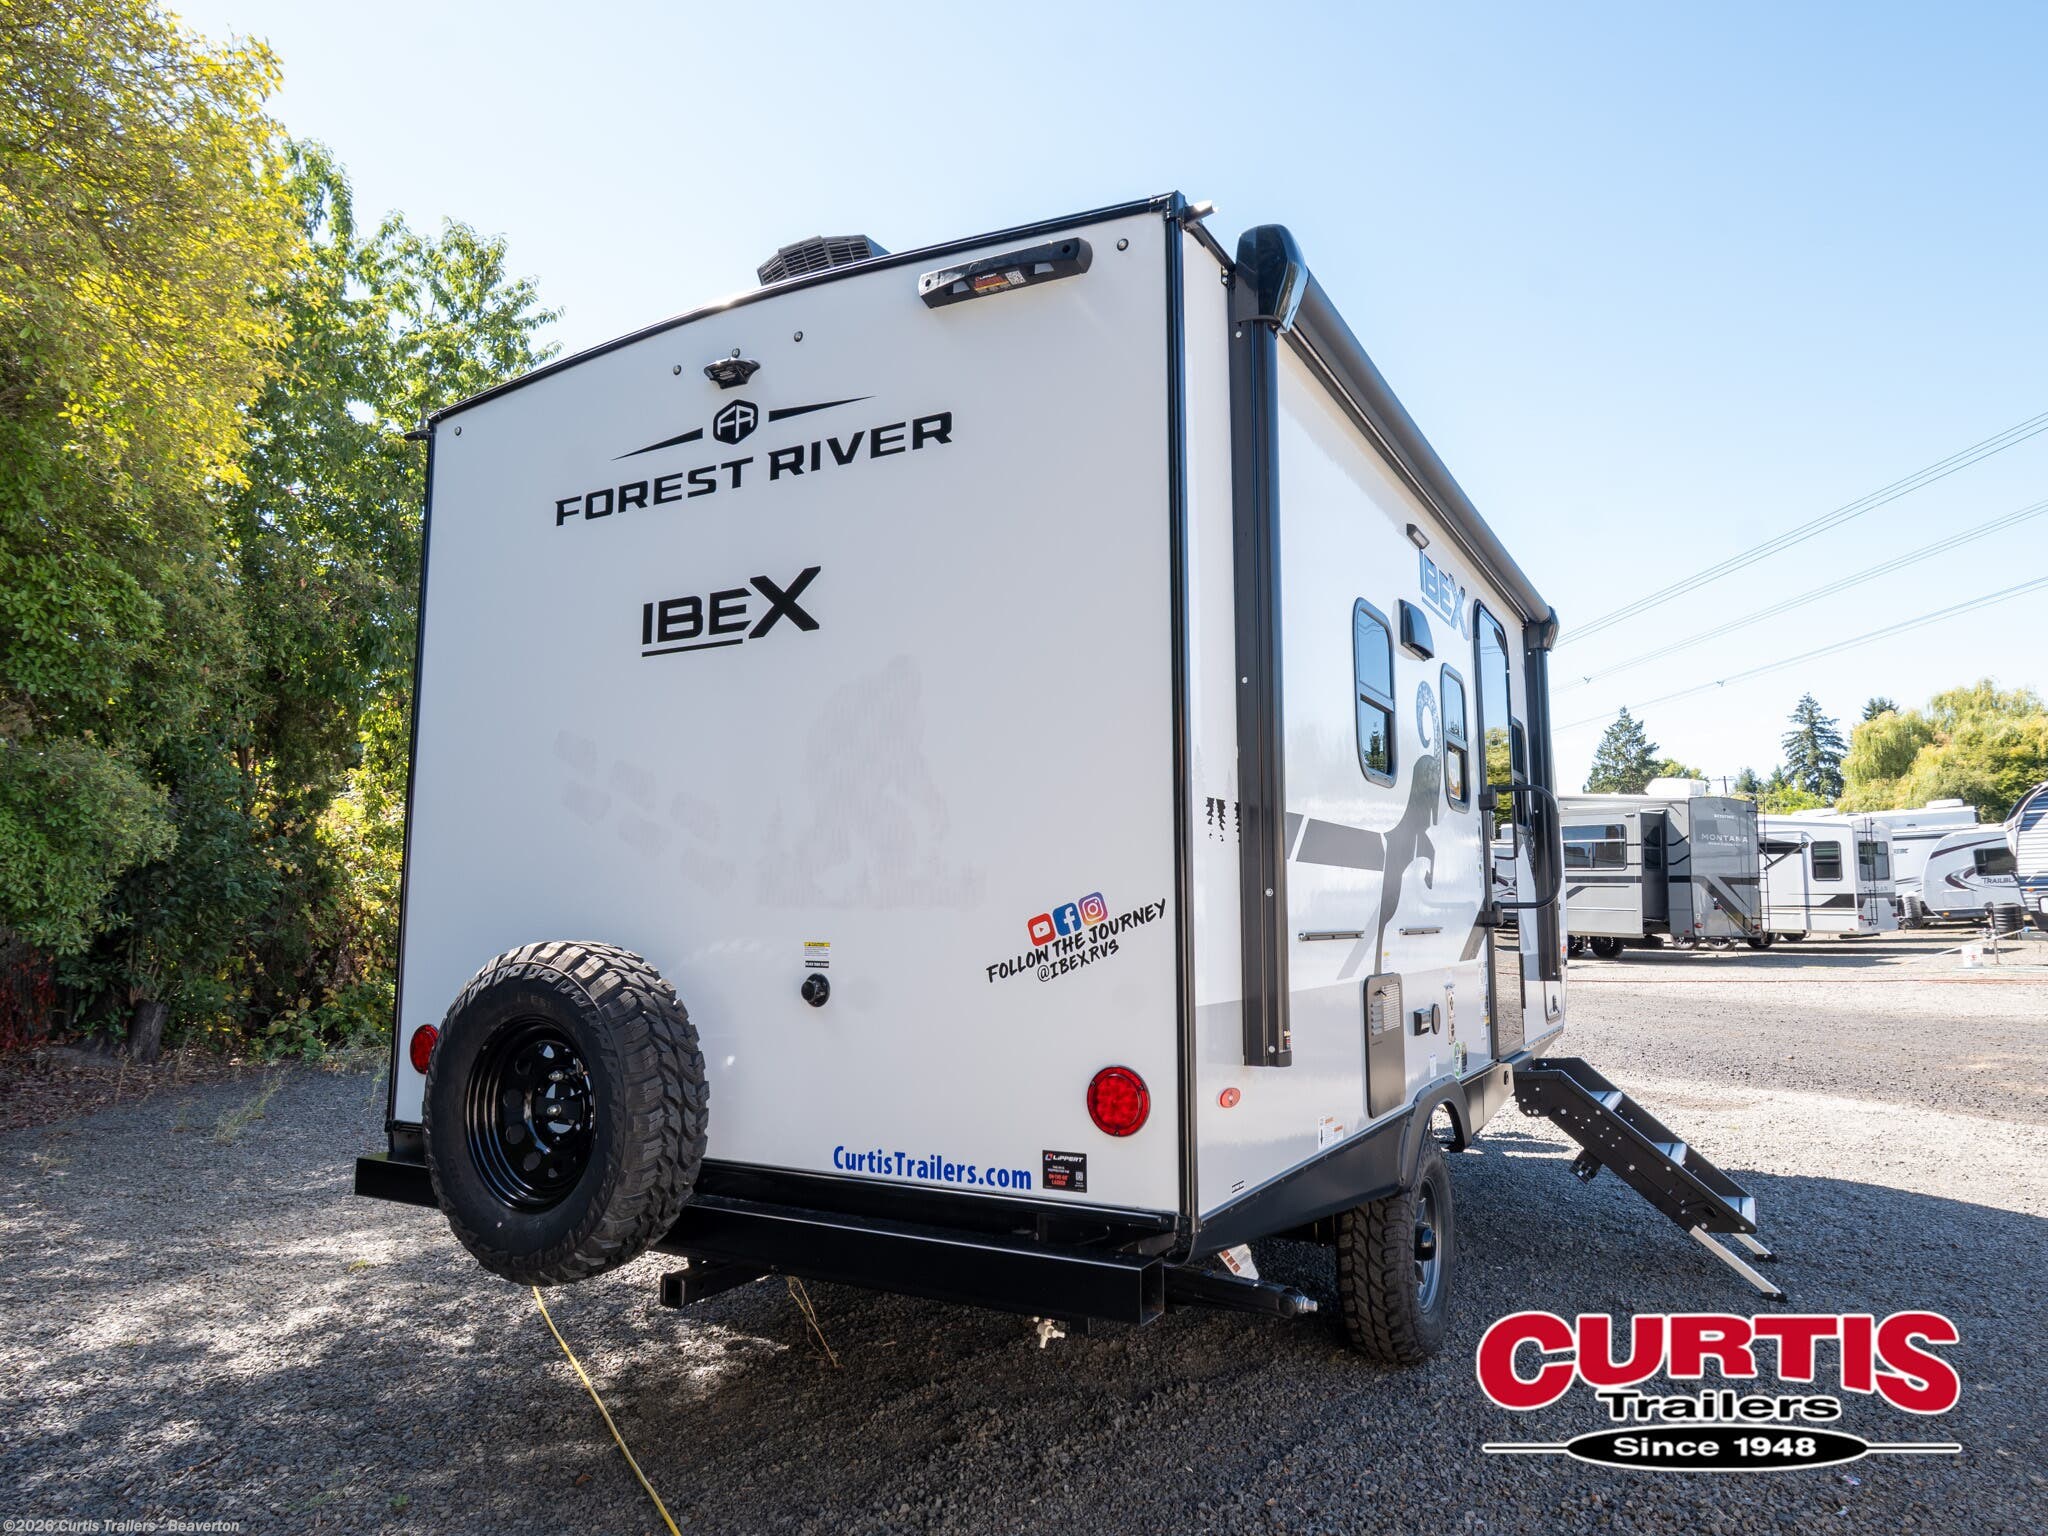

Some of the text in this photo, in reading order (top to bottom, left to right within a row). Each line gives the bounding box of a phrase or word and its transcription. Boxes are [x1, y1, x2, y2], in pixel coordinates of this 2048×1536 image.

[555, 411, 953, 527] FOREST RIVER
[642, 565, 822, 645] IBEX
[1419, 549, 1469, 641] IBEX
[1701, 833, 1748, 843] MONTANA
[986, 898, 1166, 983] FOLLOW THE JOURNEY
[1037, 938, 1120, 982] @IBEXRVS
[833, 1145, 1033, 1190] CurtisTrailers.com
[1052, 1154, 1085, 1163] LIPPERT
